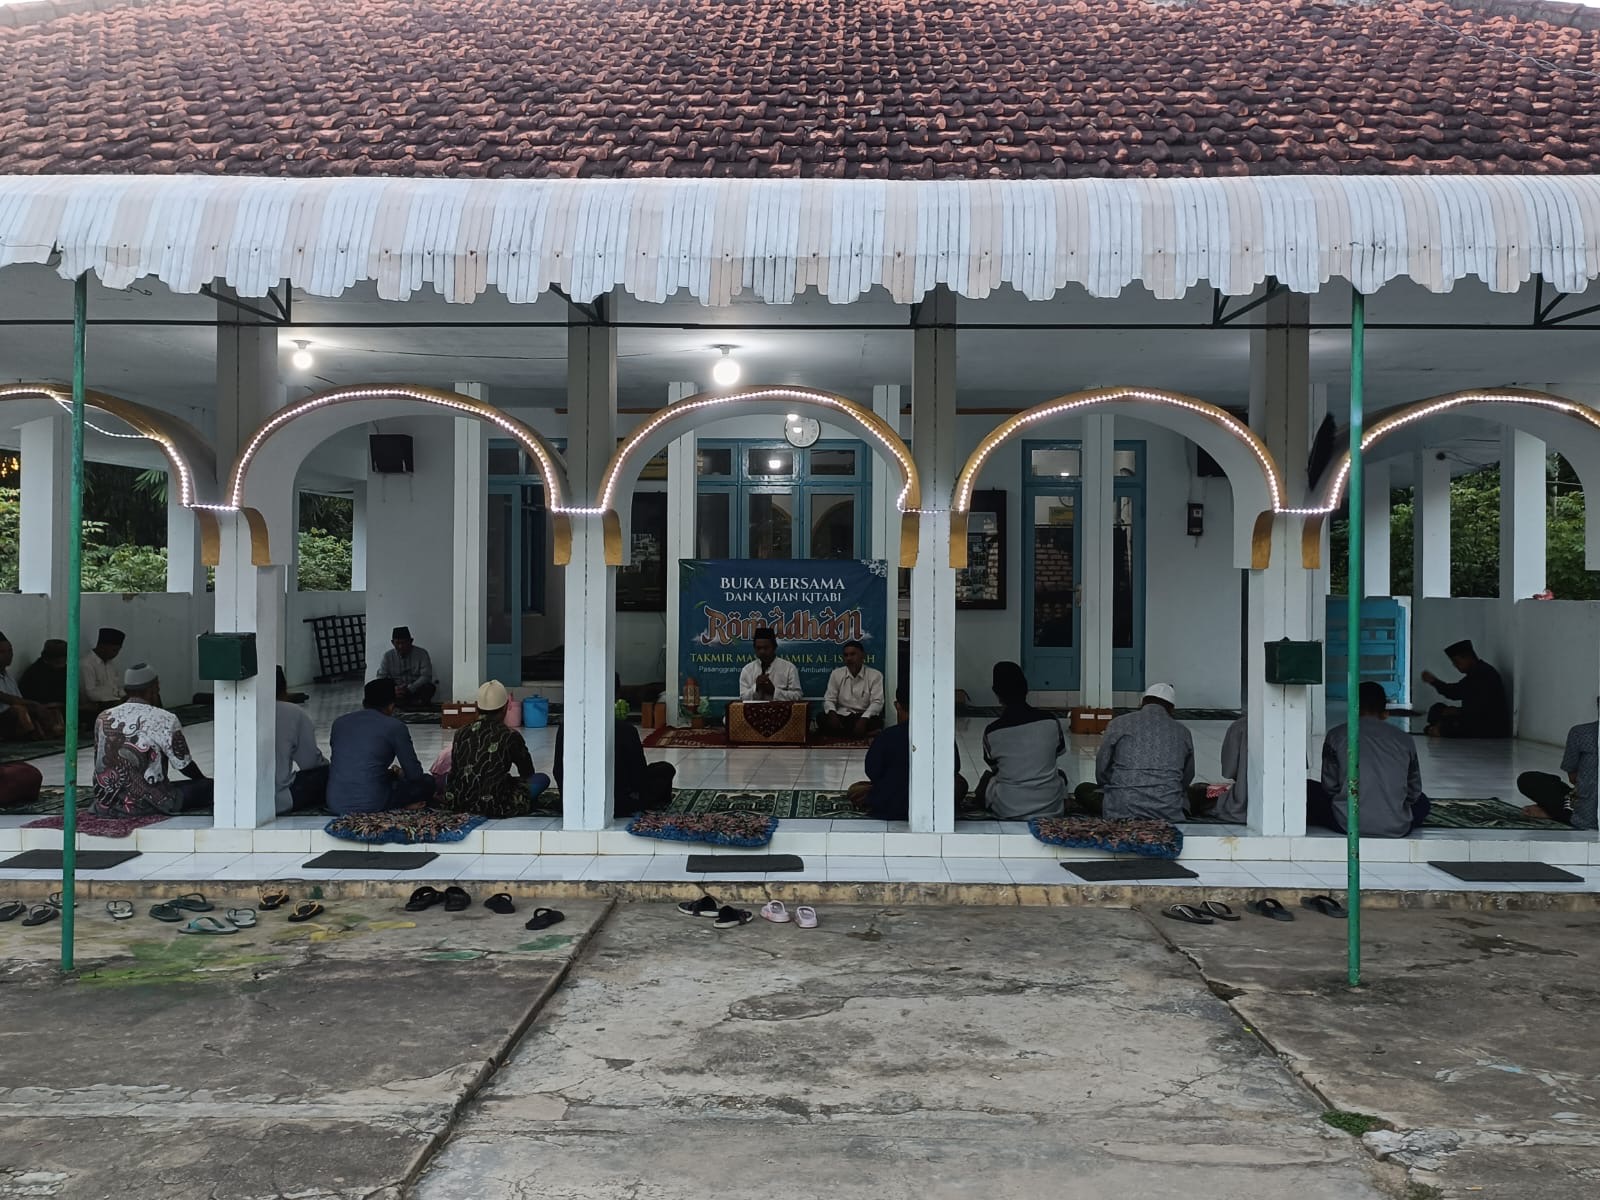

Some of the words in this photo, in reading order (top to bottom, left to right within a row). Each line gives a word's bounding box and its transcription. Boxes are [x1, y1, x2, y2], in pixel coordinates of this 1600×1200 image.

[720, 577, 765, 590] BUKA
[769, 577, 846, 590] BERSAMA
[726, 592, 752, 602] DAN
[756, 592, 798, 604] KAJIAN
[802, 592, 841, 604] KITABI
[689, 653, 733, 663] TAKMIR
